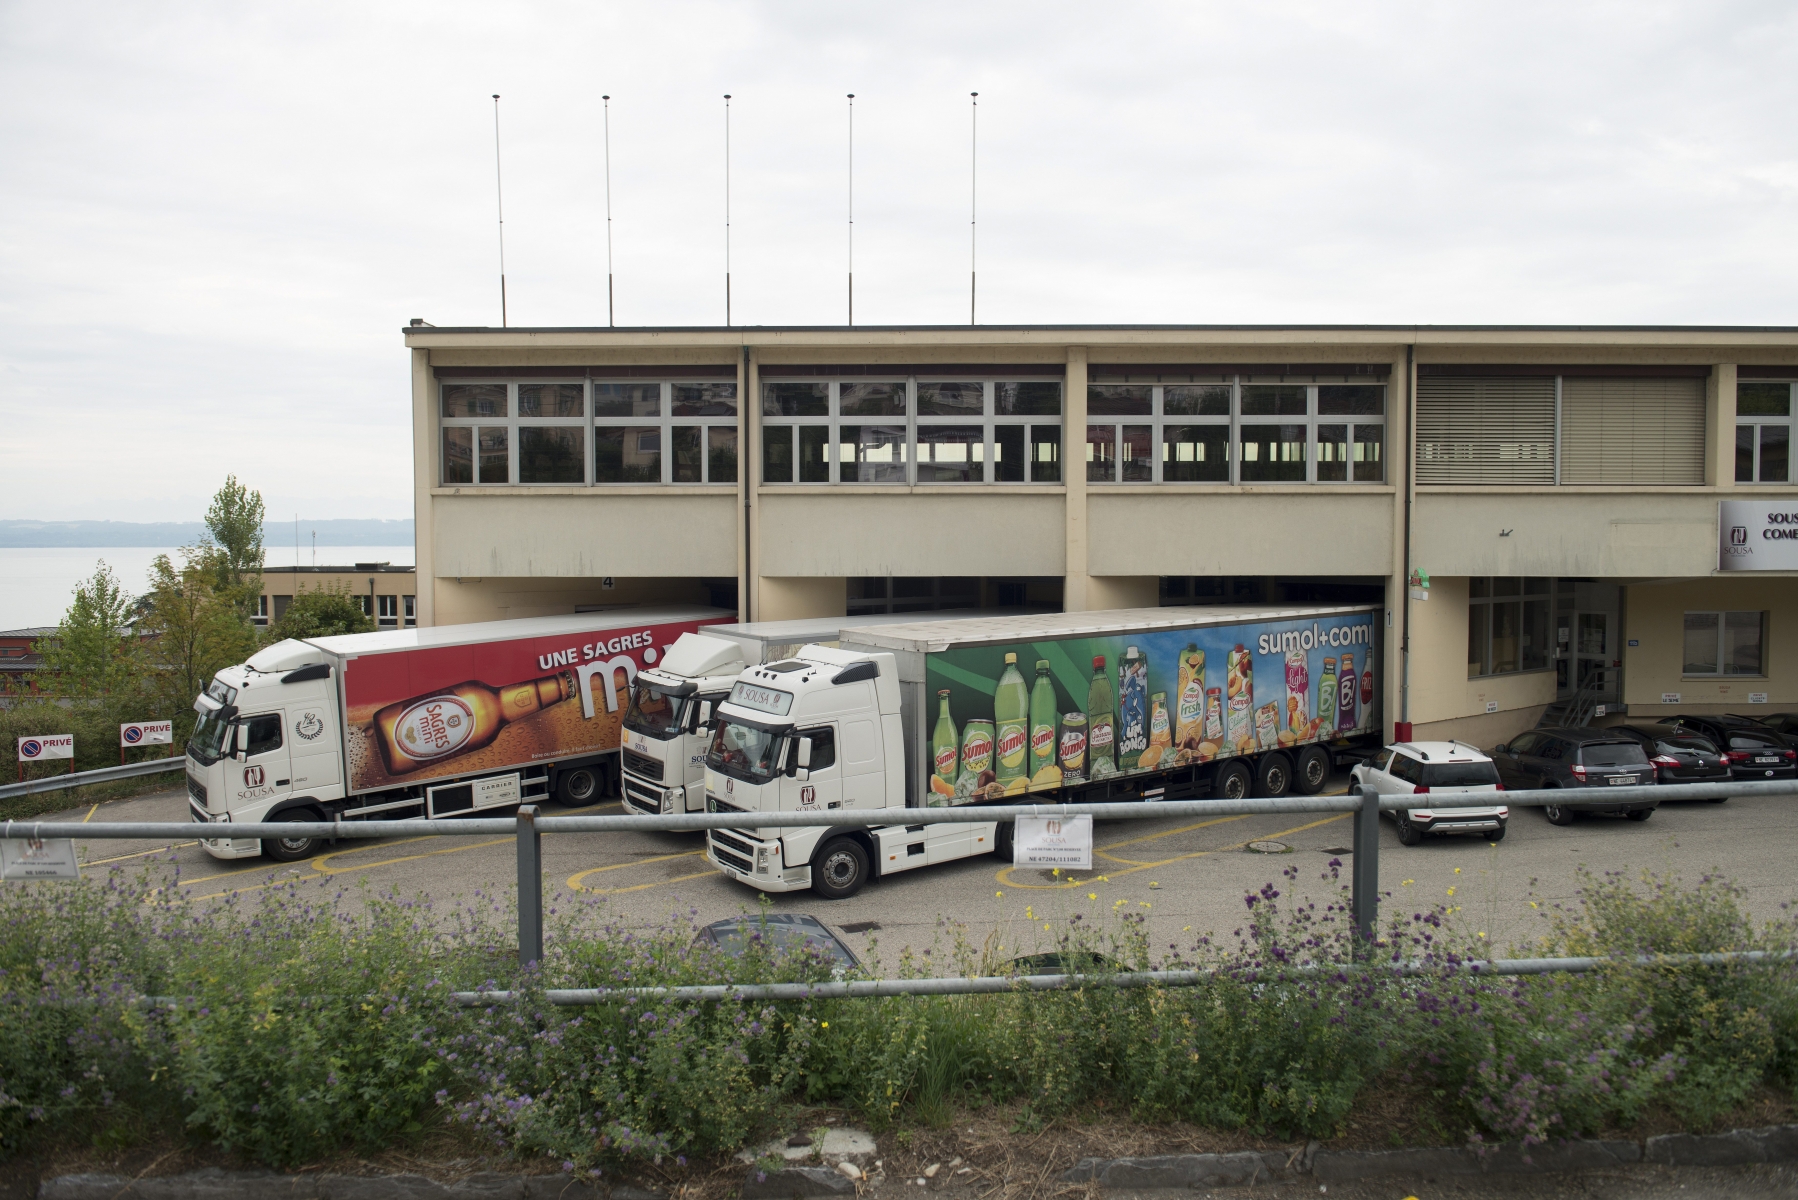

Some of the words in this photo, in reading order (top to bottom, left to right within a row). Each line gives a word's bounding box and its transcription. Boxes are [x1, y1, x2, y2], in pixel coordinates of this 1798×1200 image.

[1768, 512, 1798, 524] SOUS
[1763, 528, 1798, 540] COME
[1724, 546, 1753, 554] SOUSA
[603, 577, 613, 588] 4
[539, 648, 578, 670] UNE
[582, 630, 653, 660] SAGRES
[1288, 667, 1308, 692] Light
[744, 688, 769, 704] SOUSA
[1184, 690, 1199, 699] Compal
[1341, 680, 1356, 706] B!
[1181, 701, 1201, 715] Fresh
[1231, 698, 1250, 707] Compal
[143, 724, 170, 733] PRIVÉ
[419, 717, 434, 744] mini
[426, 704, 450, 749] SAGRES
[43, 738, 72, 747] PRIVÉ
[997, 726, 1026, 756] Sumol
[1032, 725, 1054, 748] Sumol
[1060, 729, 1087, 758] Sumol
[635, 742, 648, 753] SOUSA
[962, 734, 994, 762] Sumol
[1120, 736, 1146, 755] BONGO
[936, 747, 956, 767] Sumol
[237, 786, 274, 800] SOUSA
[482, 781, 512, 790] CARRIER
